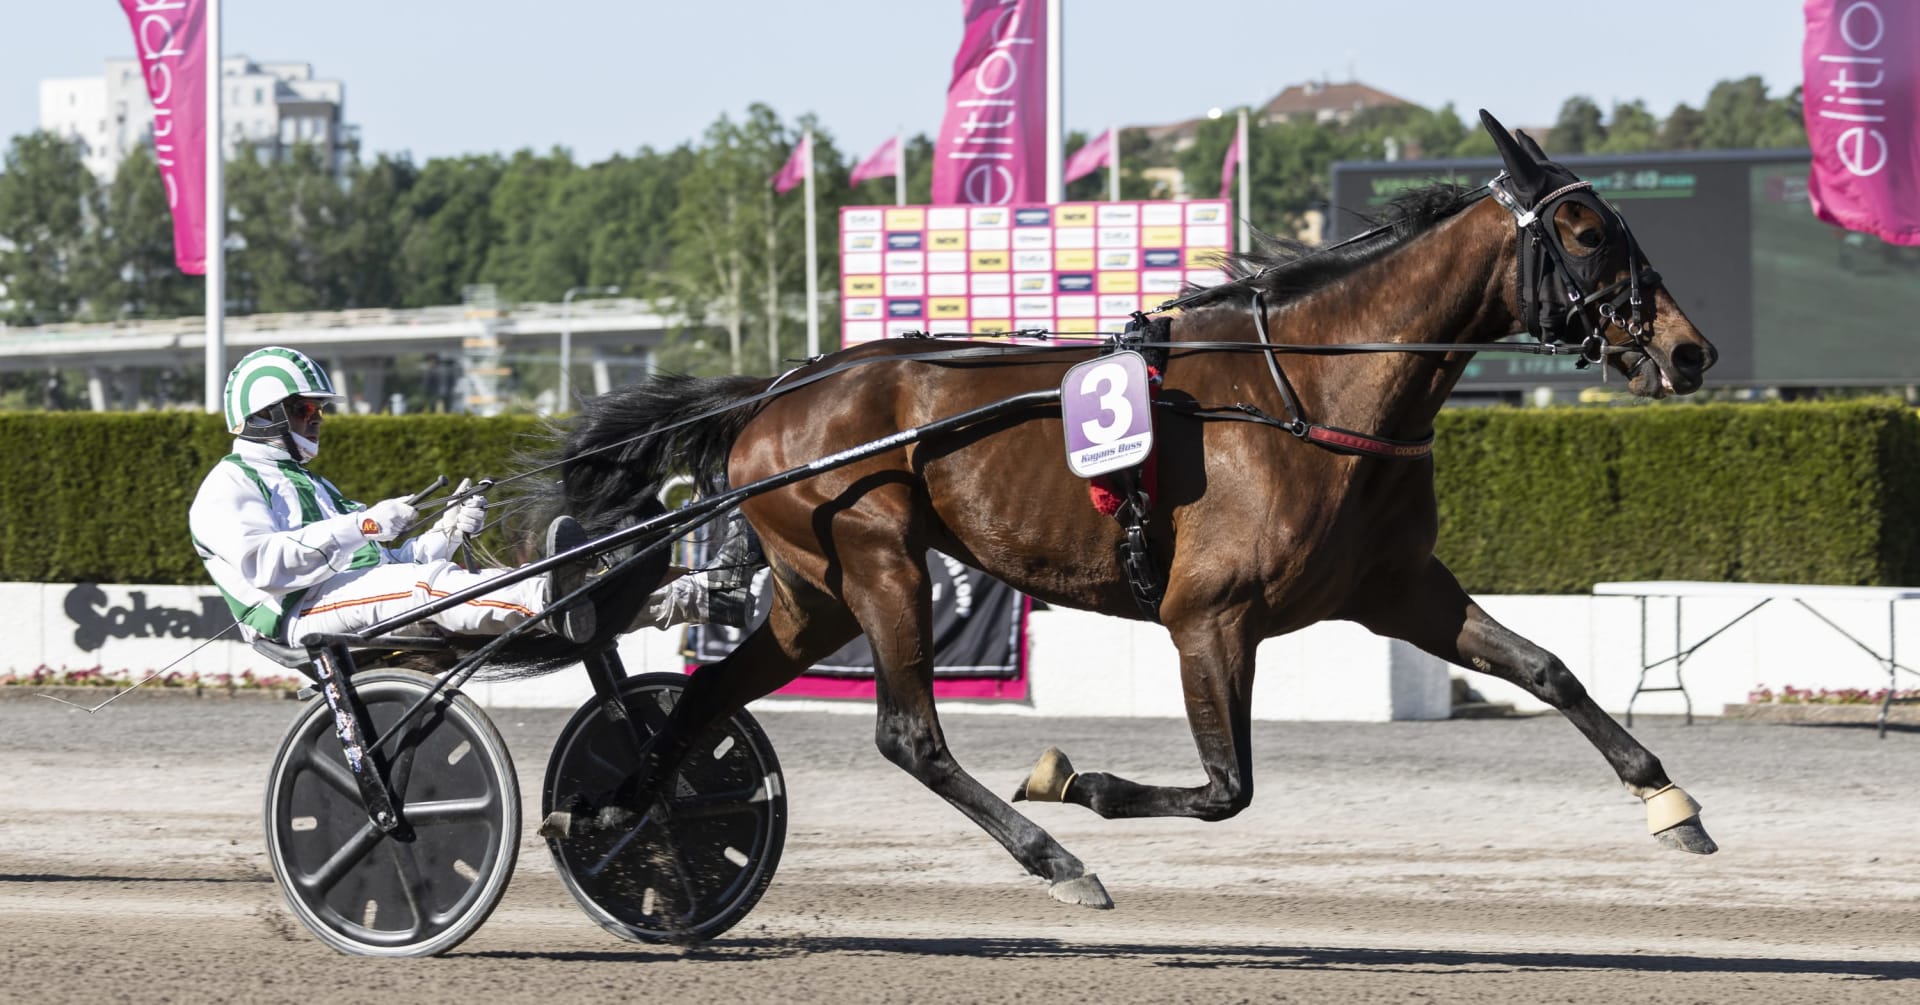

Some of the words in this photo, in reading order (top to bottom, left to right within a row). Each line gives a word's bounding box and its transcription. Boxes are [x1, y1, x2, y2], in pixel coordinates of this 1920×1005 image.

[1818, 1, 1888, 177] elitlo
[1080, 363, 1133, 445] 3
[1118, 440, 1143, 453] Boss
